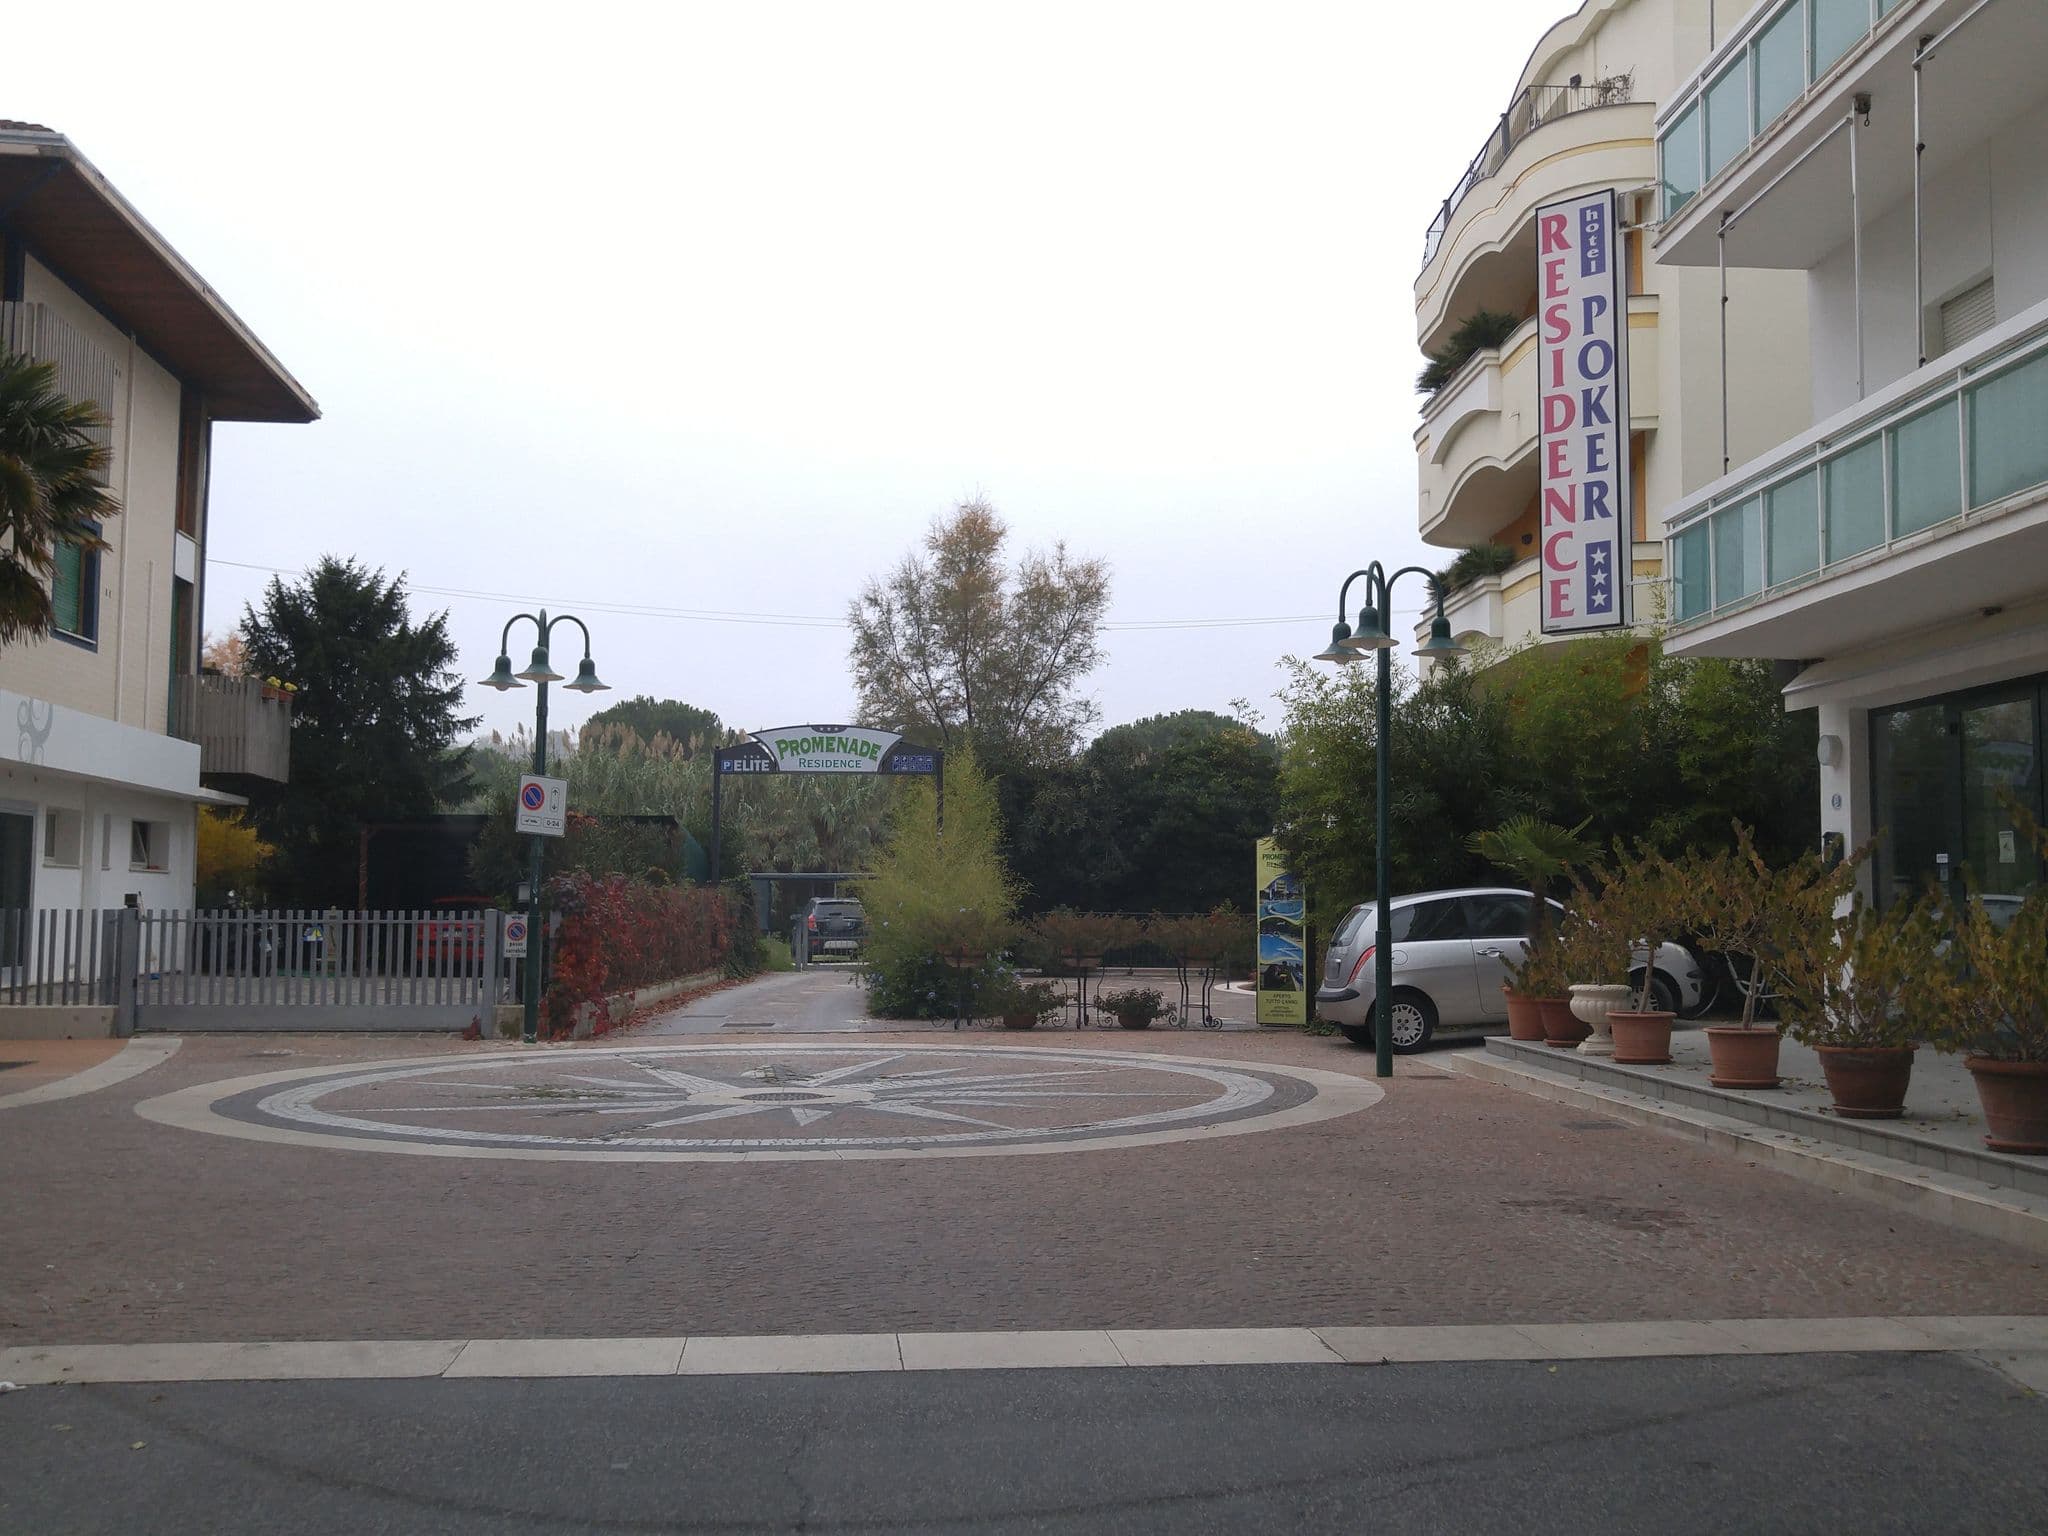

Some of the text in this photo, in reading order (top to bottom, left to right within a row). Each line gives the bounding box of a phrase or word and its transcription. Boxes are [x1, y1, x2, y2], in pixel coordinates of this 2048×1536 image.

[1585, 208, 1600, 273] hotel
[1540, 213, 1578, 619] RESIDENCE
[1577, 295, 1613, 521] POKER
[733, 759, 770, 771] ELITE
[775, 736, 882, 761] PROMENADE
[799, 757, 862, 769] RESIDENCE
